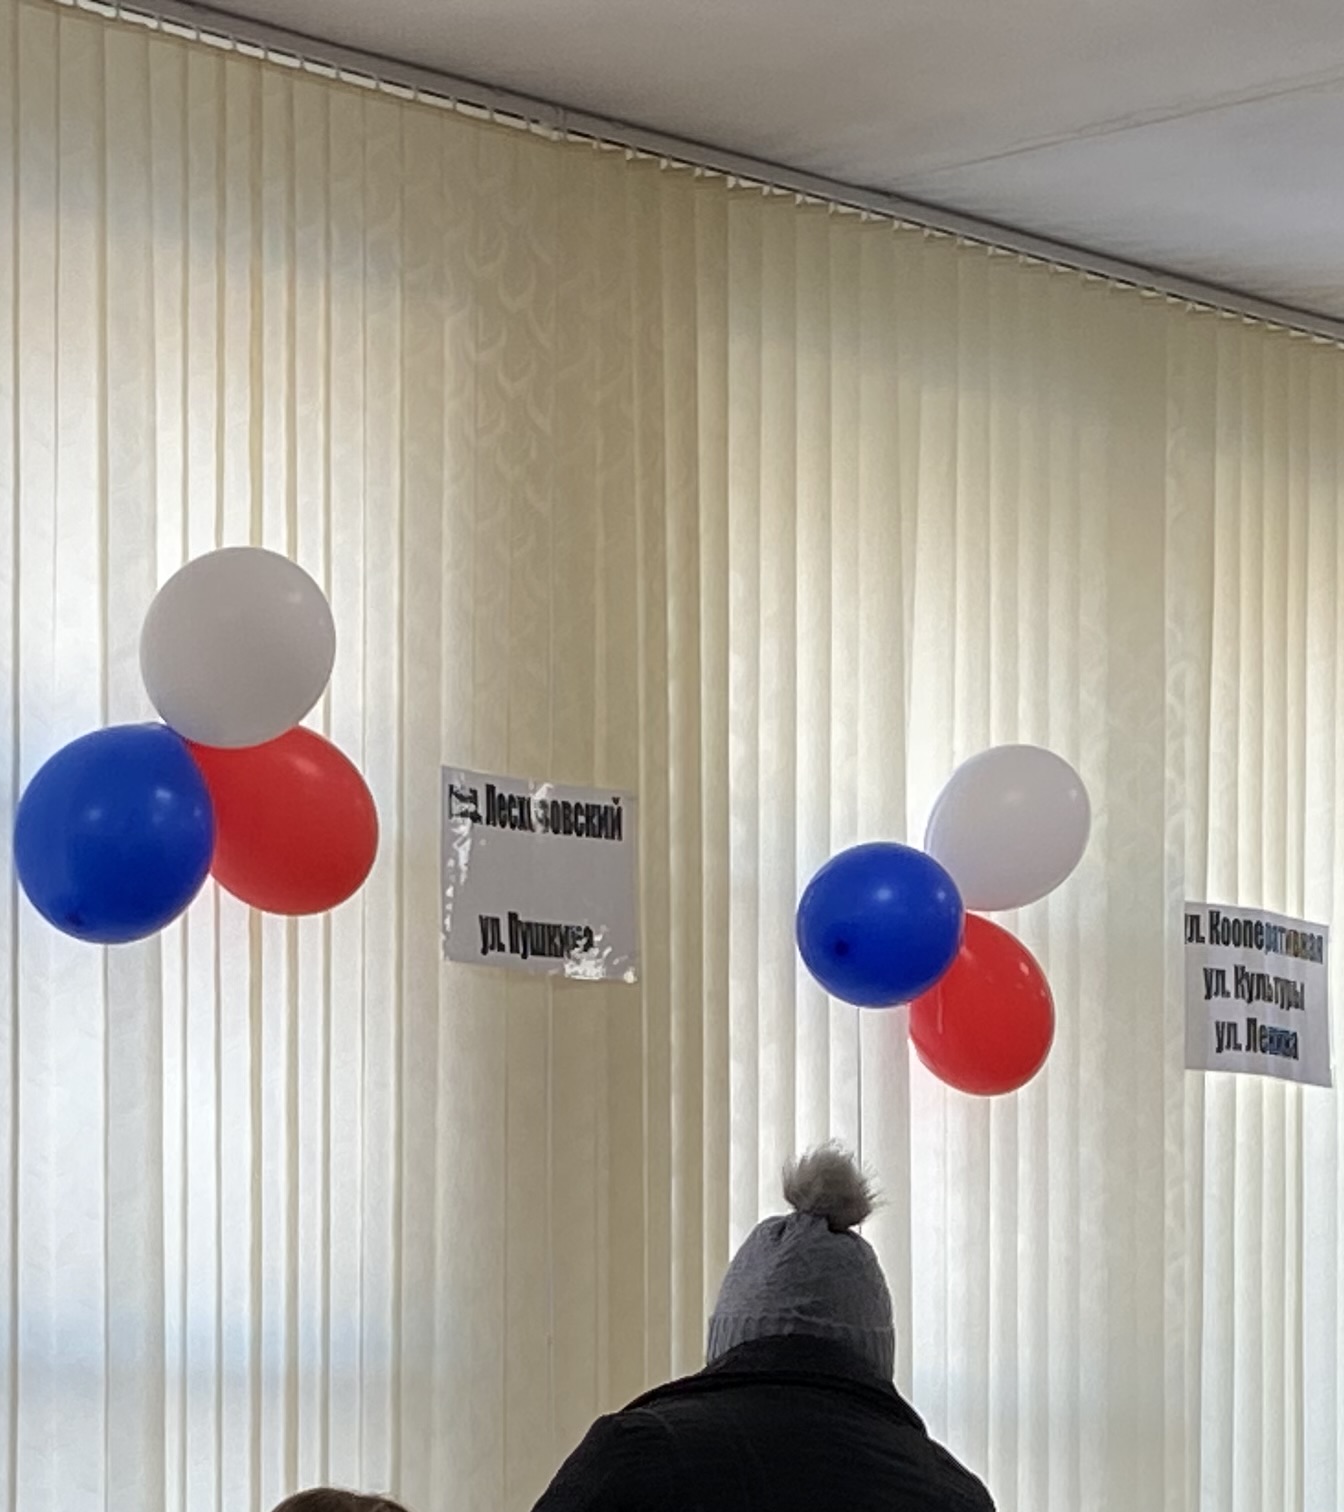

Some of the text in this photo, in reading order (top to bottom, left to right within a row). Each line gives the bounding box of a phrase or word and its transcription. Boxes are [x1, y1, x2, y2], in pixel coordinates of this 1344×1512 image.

[479, 914, 506, 956] ул.
[1203, 963, 1305, 1011] ул. Культуры
[1214, 1017, 1299, 1060] ул. Леа
